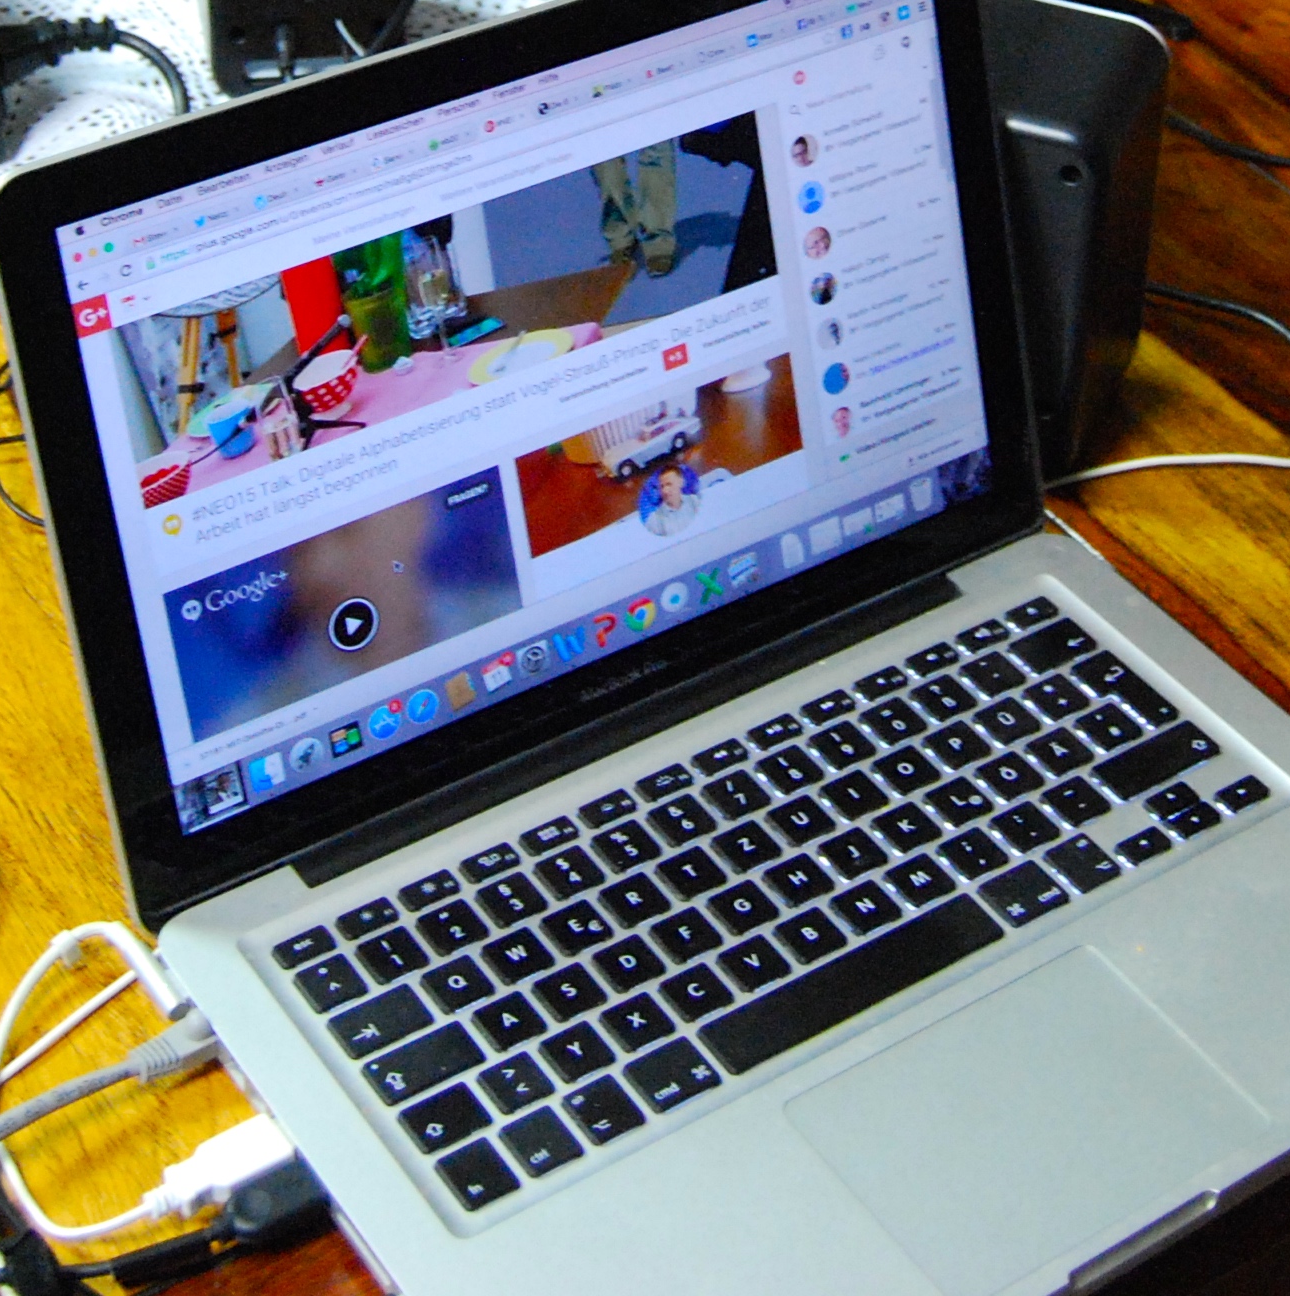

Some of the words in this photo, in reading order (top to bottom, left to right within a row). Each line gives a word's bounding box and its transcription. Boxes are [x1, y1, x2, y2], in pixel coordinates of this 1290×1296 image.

[100, 206, 143, 226] Chrome
[197, 172, 250, 194] Bearbeiten
[264, 153, 309, 173] Anzeigen
[320, 137, 355, 155] Verlauf
[366, 116, 424, 139] Lesezeichen
[437, 99, 480, 117] Personen
[492, 83, 526, 100] Fenster
[299, 451, 355, 483] Digitale
[358, 403, 481, 460] Alphabetisierung
[483, 390, 516, 413] statt
[671, 322, 690, 343] Die
[695, 300, 747, 332] Zukunft
[749, 290, 770, 312] der
[194, 515, 241, 544] Arbeit
[244, 503, 270, 526] hat
[323, 457, 398, 496] begonnen
[205, 568, 290, 615] Google+
[840, 744, 855, 755] 9
[947, 737, 963, 750] P
[787, 768, 803, 780] 8
[897, 762, 915, 775] O
[733, 792, 747, 805] 7
[847, 788, 860, 799] I
[949, 795, 967, 806] L
[681, 818, 695, 830] 6
[790, 811, 810, 825] U
[896, 819, 916, 833] K
[623, 844, 639, 857] 5
[737, 837, 756, 852] Z
[847, 845, 861, 858] J
[569, 871, 582, 882] 4
[681, 864, 697, 877] T
[787, 870, 809, 885] H
[909, 870, 932, 887] M
[509, 898, 525, 911] 3
[625, 891, 643, 905] R
[733, 898, 752, 912] G
[855, 897, 876, 913] N
[449, 925, 466, 938] 2
[567, 918, 585, 932] E
[677, 925, 691, 940] F
[800, 926, 819, 940] B
[390, 954, 404, 965] 1
[505, 944, 528, 961] W
[618, 954, 637, 969] D
[743, 953, 761, 967] V
[447, 974, 468, 989] Q
[560, 982, 577, 997] S
[687, 982, 705, 997] C
[501, 1012, 519, 1028] A
[626, 1012, 647, 1028] X
[566, 1041, 583, 1056] Y
[653, 1082, 681, 1100] cmd
